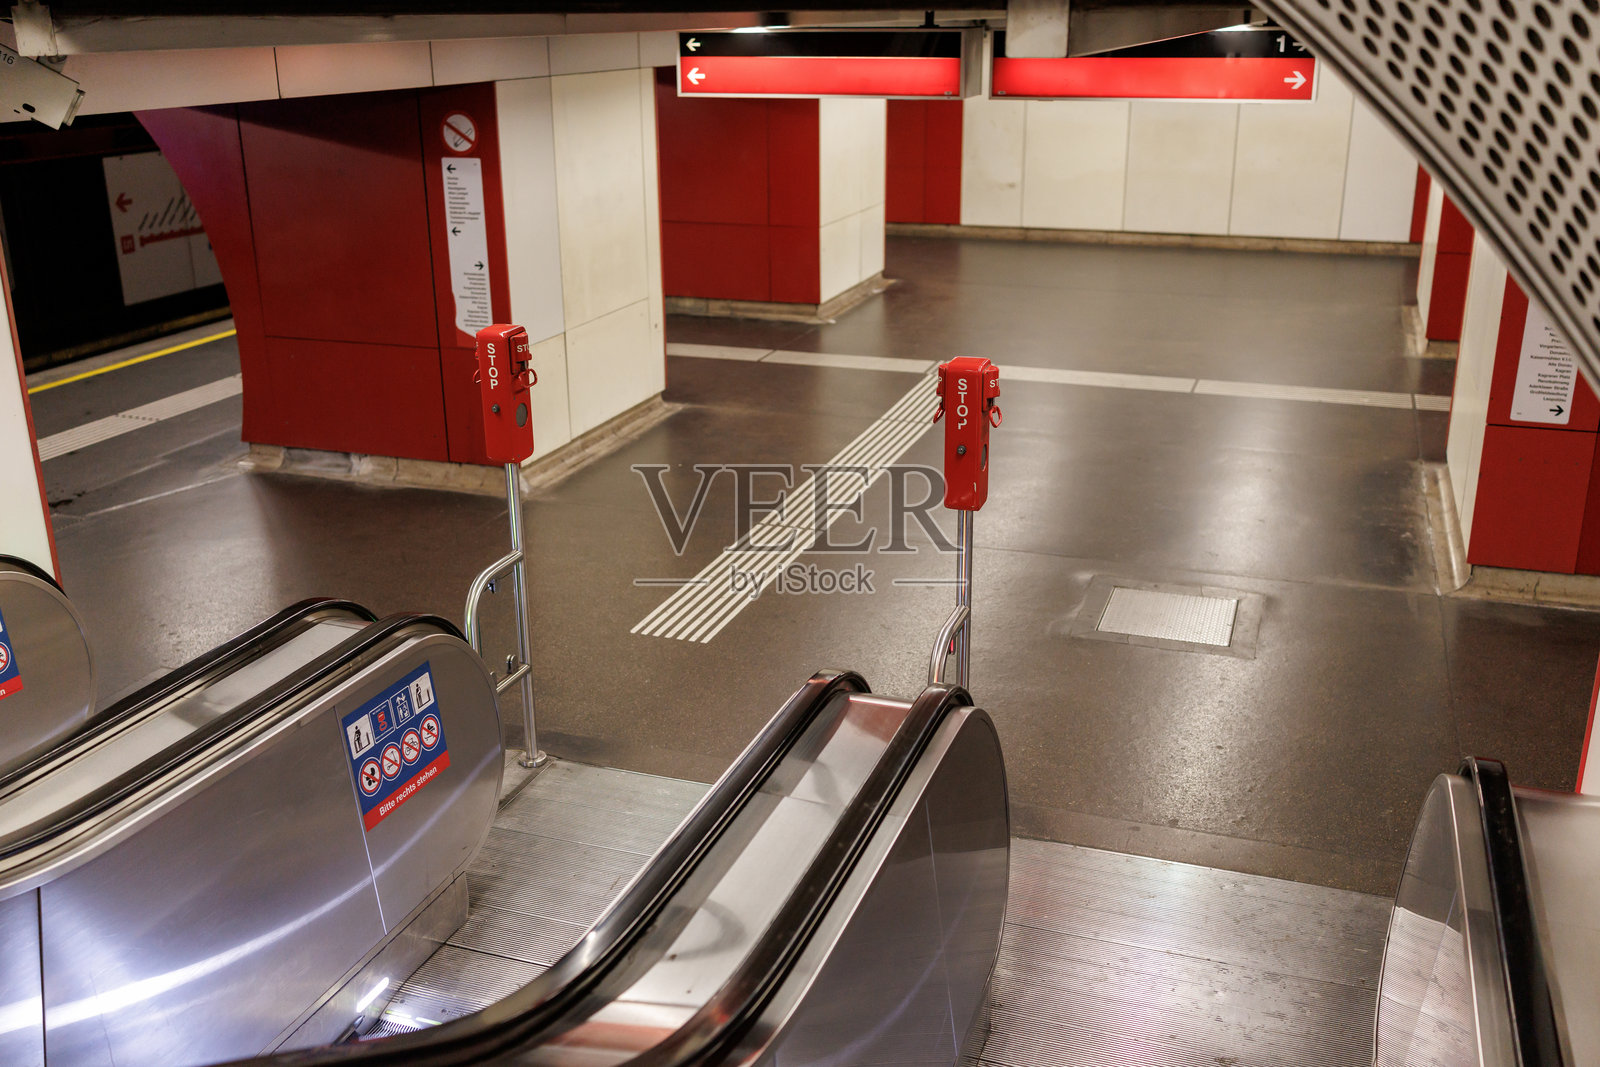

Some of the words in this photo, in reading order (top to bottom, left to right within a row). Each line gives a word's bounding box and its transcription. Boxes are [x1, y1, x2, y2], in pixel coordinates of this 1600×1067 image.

[0, 50, 15, 65] 16
[1276, 34, 1286, 53] 1
[487, 342, 499, 390] STOP
[956, 378, 969, 430] STOP
[379, 799, 396, 816] Bitte
[395, 783, 417, 803] rechts
[416, 766, 438, 787] stehen
